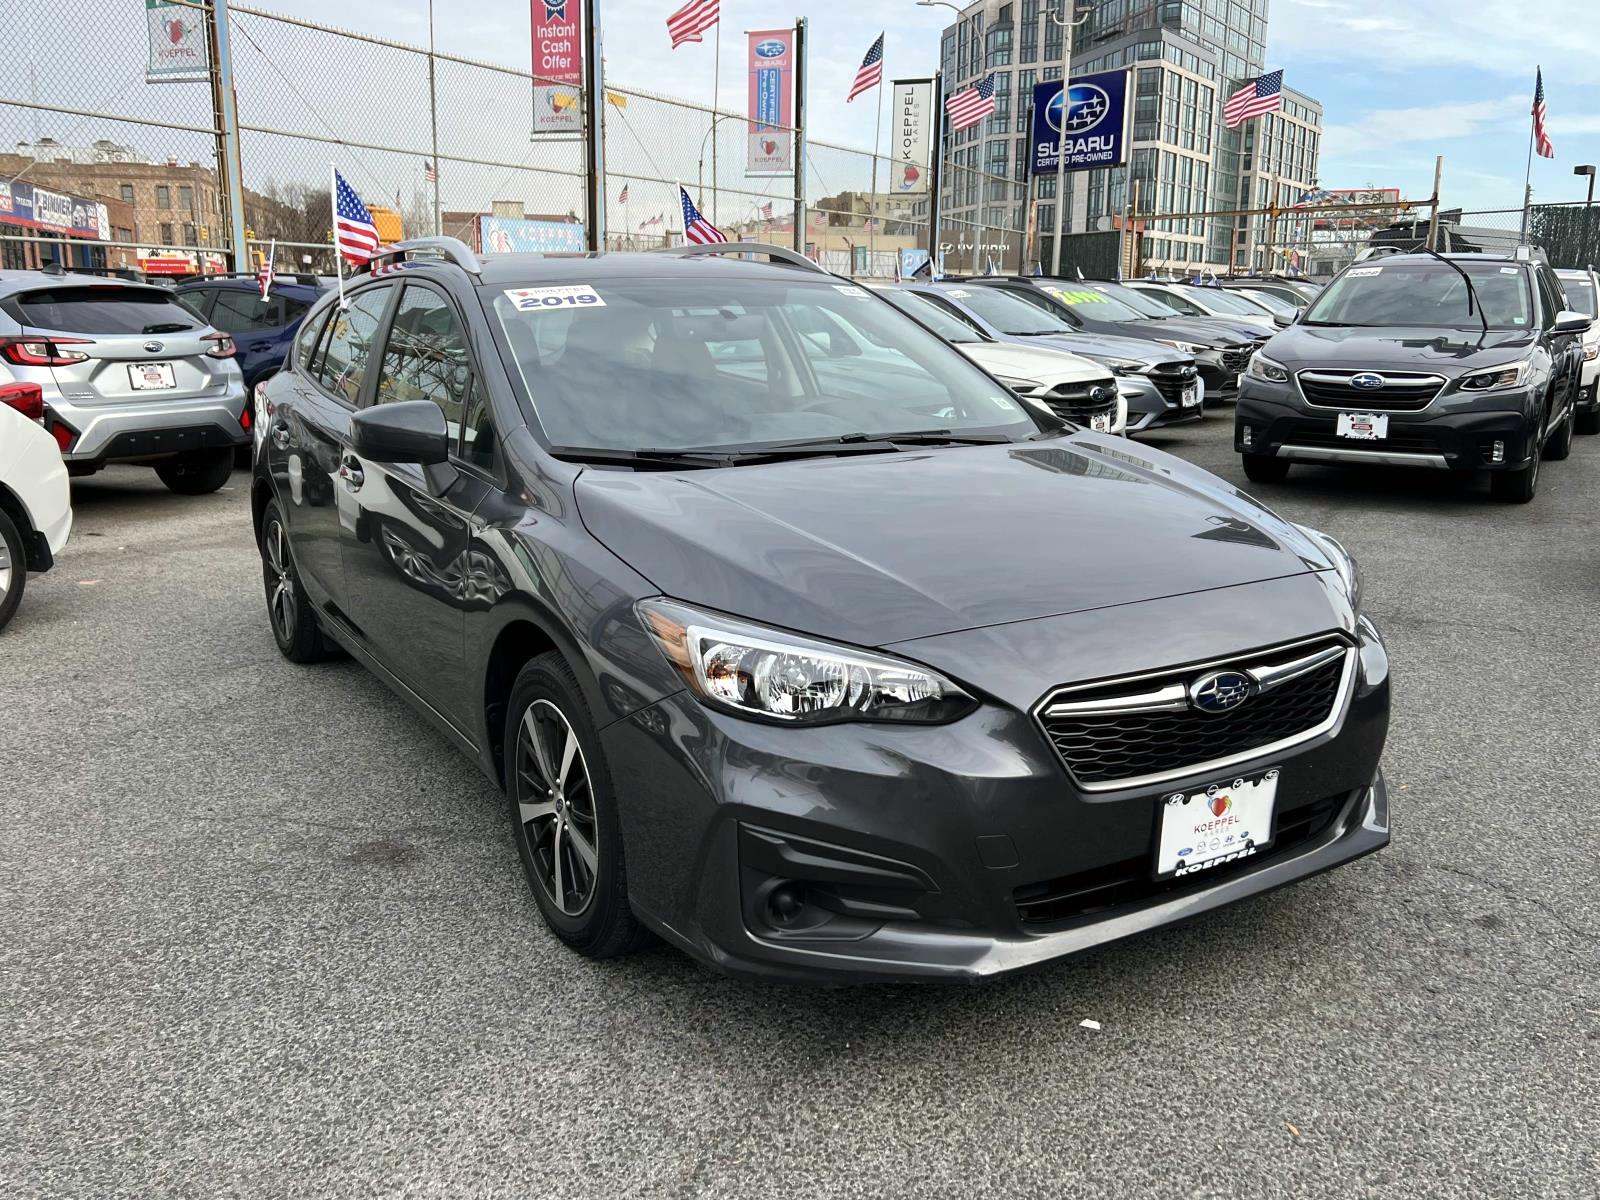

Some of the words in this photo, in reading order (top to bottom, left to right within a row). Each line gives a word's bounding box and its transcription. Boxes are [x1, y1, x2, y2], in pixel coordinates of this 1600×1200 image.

[537, 22, 575, 38] Instant
[541, 39, 571, 54] Cash
[542, 55, 571, 69] Offer
[903, 86, 914, 160] KOEPPEL
[1037, 134, 1114, 158] SUBARU
[1037, 155, 1070, 167] CERTIFD
[1071, 151, 1113, 164] PRE-OWNED
[519, 294, 598, 308] 2019
[1194, 815, 1241, 834] KOEPPEL
[1174, 847, 1257, 877] KOEPPEL
